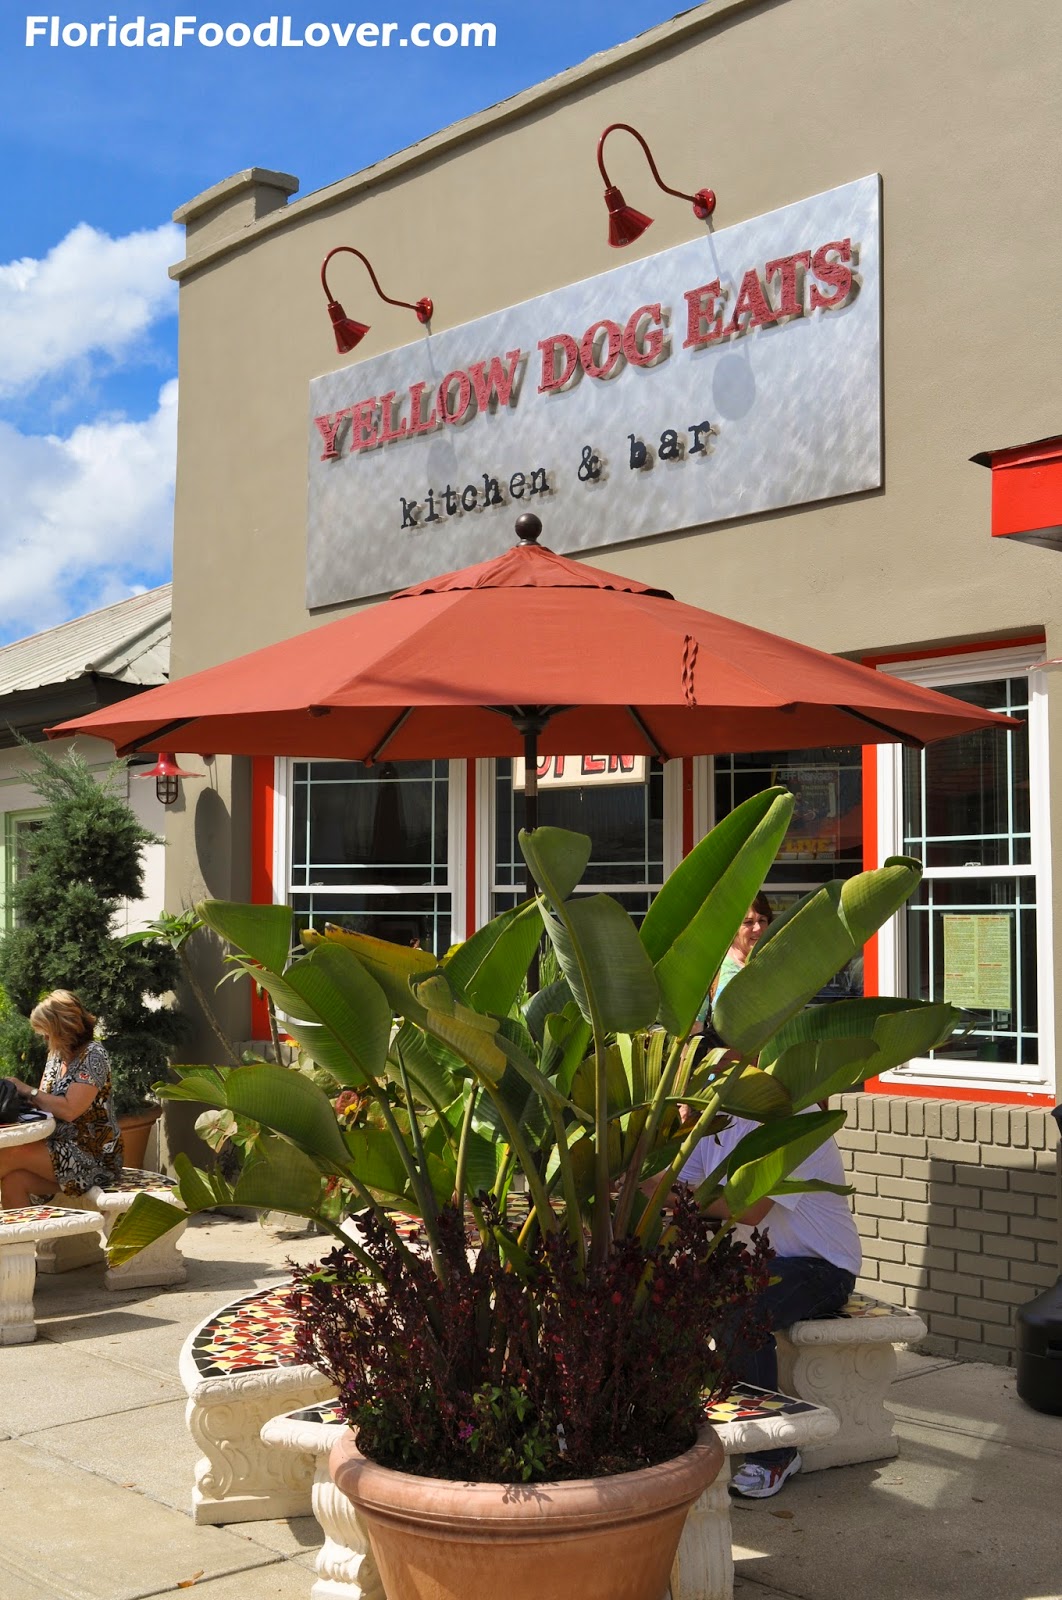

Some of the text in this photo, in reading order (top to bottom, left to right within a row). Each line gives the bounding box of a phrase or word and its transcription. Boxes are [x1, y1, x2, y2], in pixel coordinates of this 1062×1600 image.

[314, 238, 852, 462] YELLOW DOG EATS
[400, 421, 711, 529] kitchen & bar
